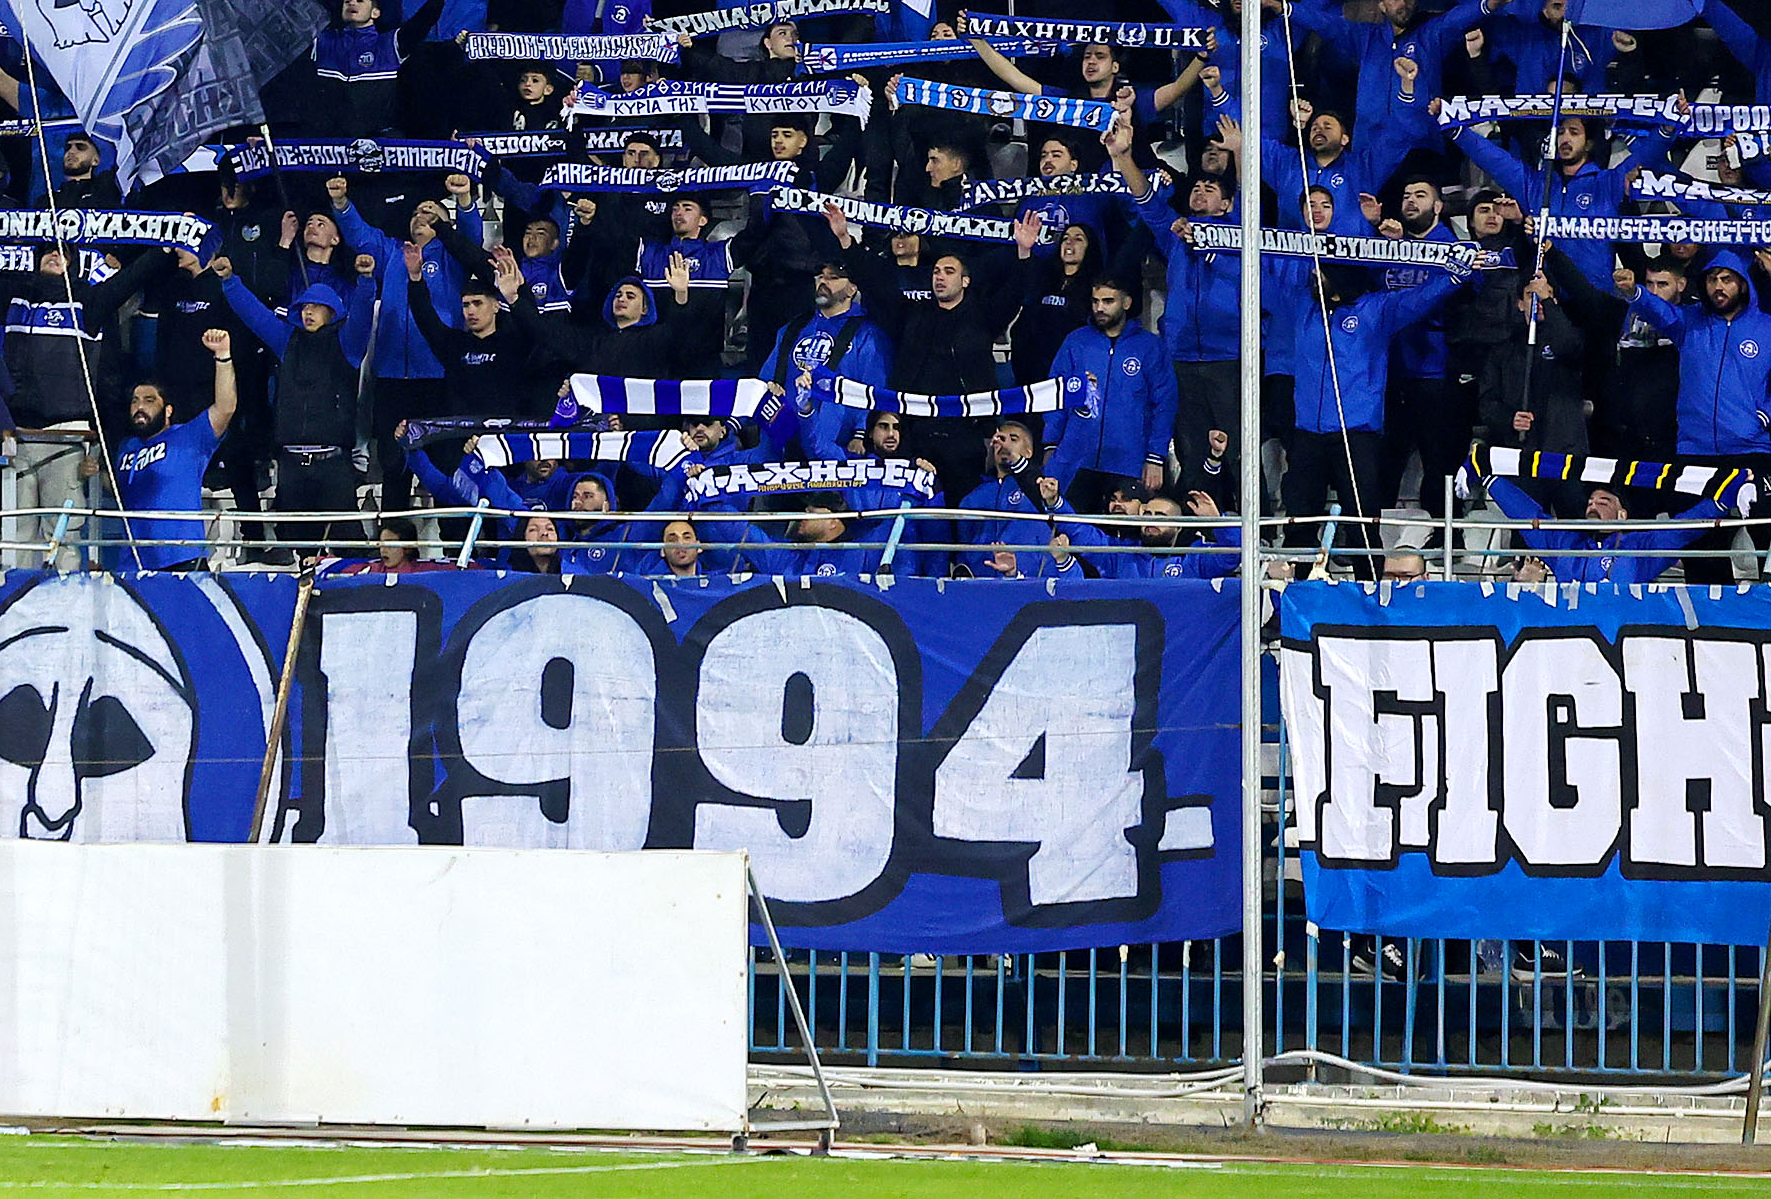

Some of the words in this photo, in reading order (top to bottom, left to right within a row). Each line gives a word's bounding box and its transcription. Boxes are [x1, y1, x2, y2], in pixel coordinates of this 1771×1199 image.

[969, 17, 1111, 43] ΜΑΧΗΤΕC
[1154, 27, 1202, 47] U.K
[614, 99, 661, 115] ΚΥΡΙΑ
[671, 97, 700, 113] ΤΗΣ
[750, 97, 820, 112] ΚΥΠΡΟΥ
[85, 211, 209, 247] ΜΑΧΗΤΕC
[1318, 636, 1771, 868] FIGH
